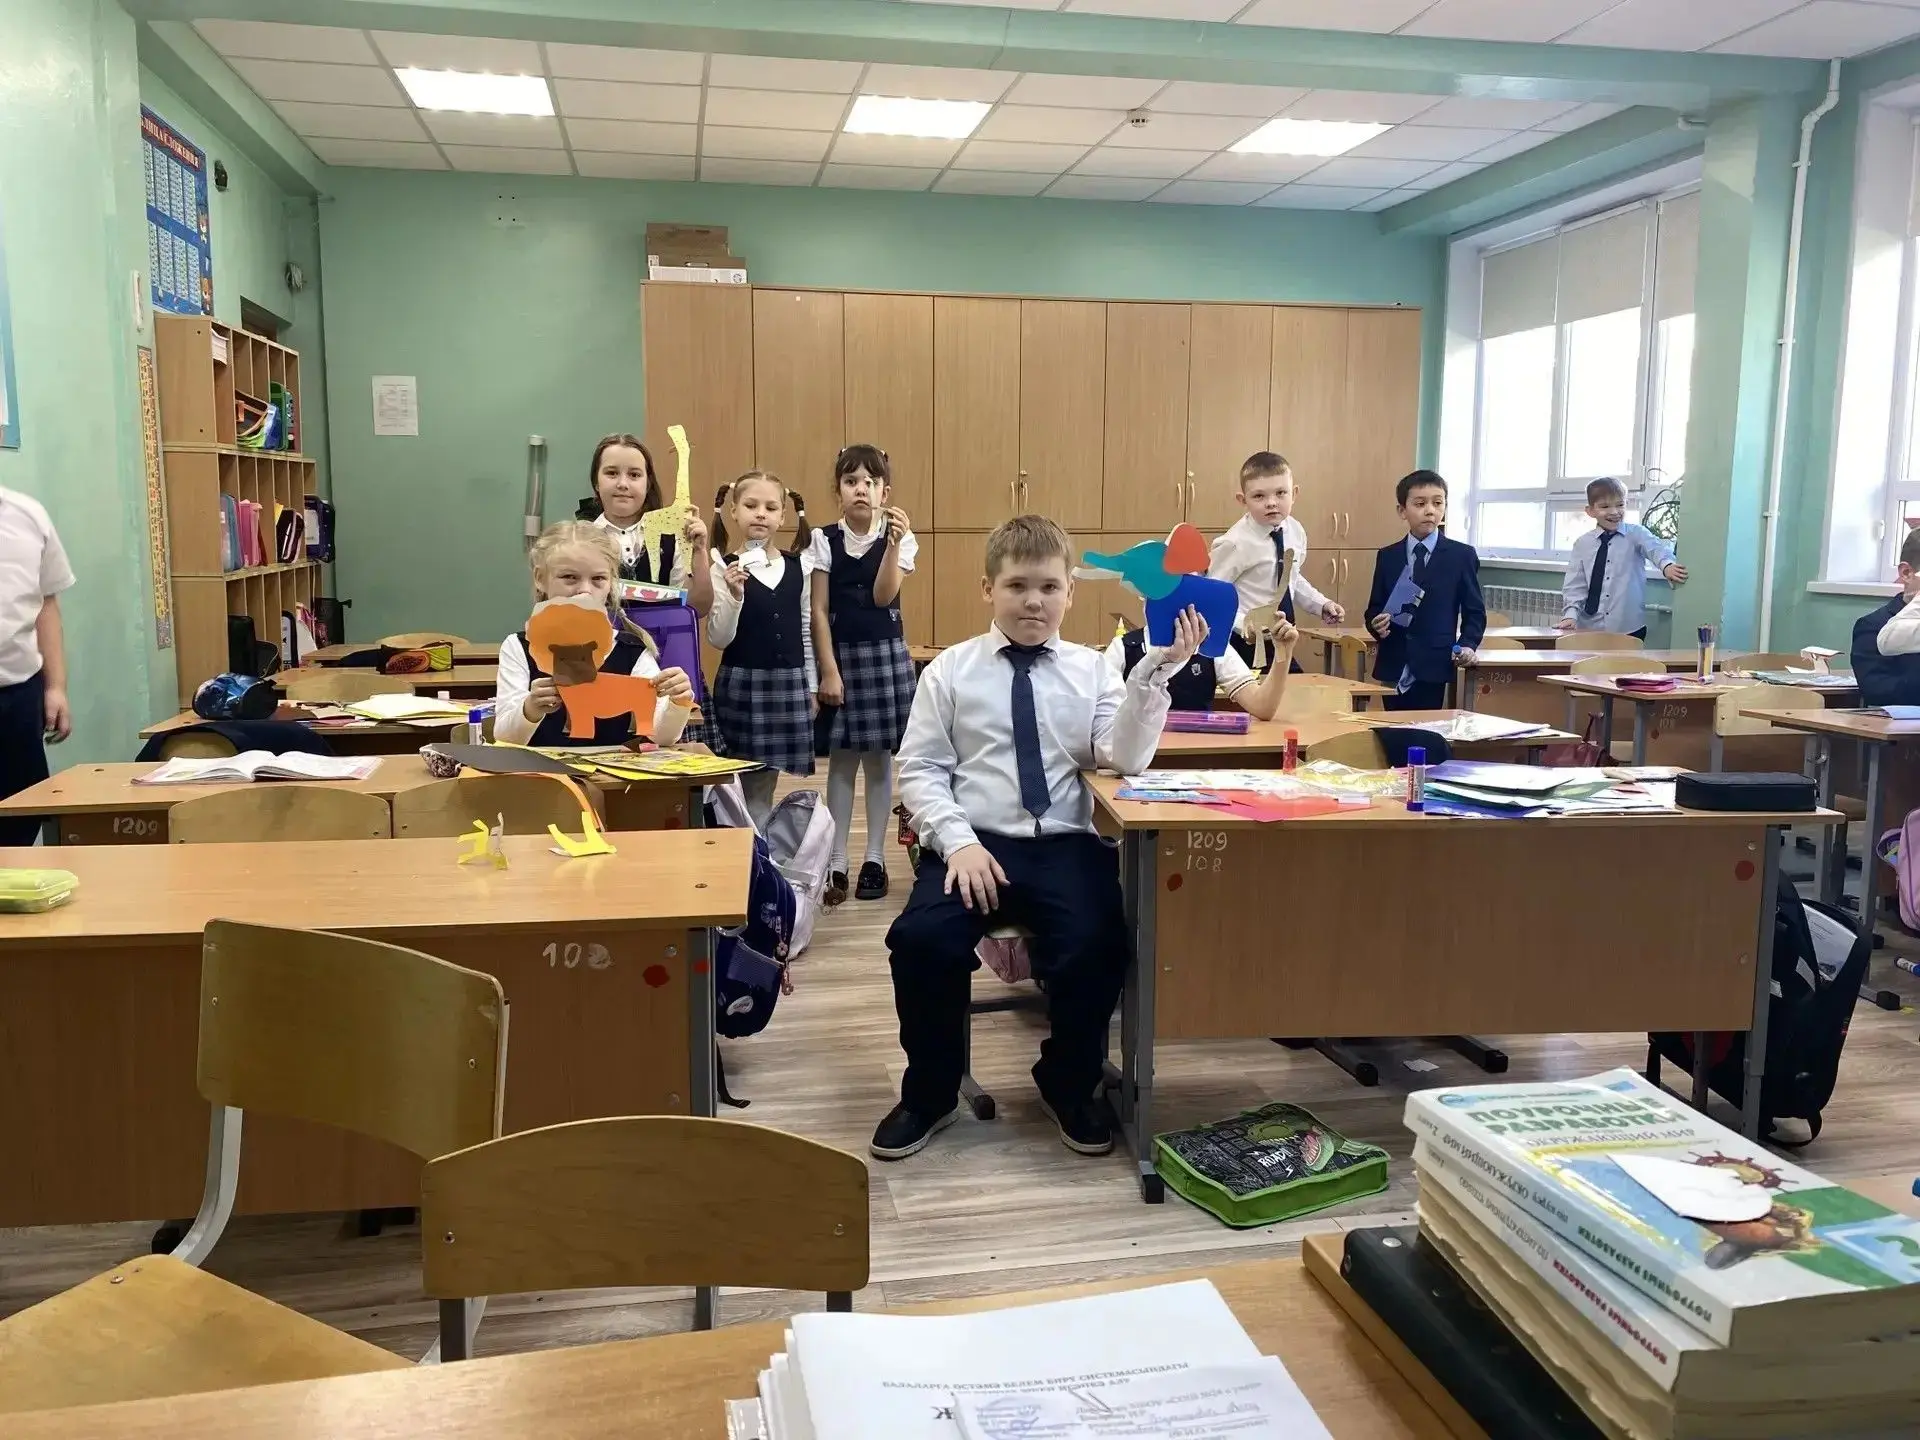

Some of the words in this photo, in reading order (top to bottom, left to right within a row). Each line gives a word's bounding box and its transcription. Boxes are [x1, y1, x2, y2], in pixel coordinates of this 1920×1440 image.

[1663, 703, 1688, 718] 1209
[113, 816, 158, 836] 1209
[1187, 830, 1227, 851] 1209
[1186, 855, 1223, 872] 108
[1577, 1225, 1641, 1276] РАЗРАБОТКИ
[1552, 1259, 1608, 1312] РАЗРАБОТКИ
[1643, 1269, 1713, 1323] ПОУРОЧНЫЕ
[1607, 1307, 1668, 1365] ПОУРОЧНЫЕ
